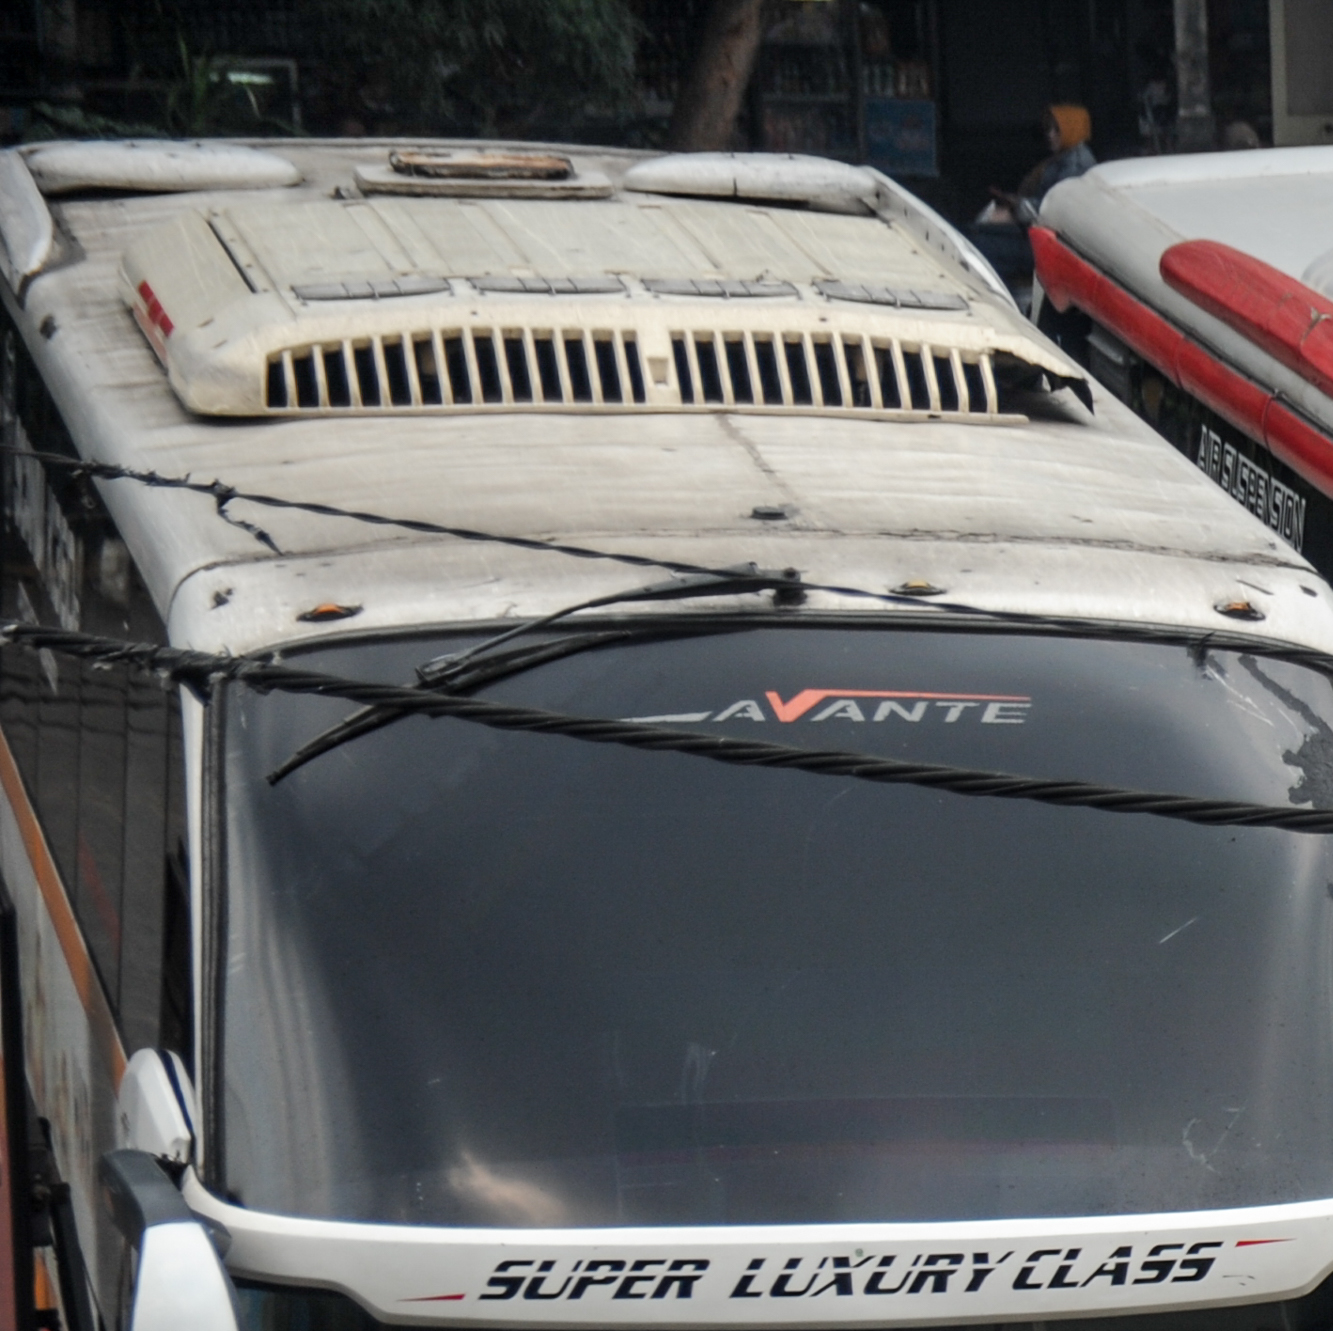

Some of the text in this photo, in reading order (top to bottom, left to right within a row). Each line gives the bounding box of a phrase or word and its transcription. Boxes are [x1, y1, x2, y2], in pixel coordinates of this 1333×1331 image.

[711, 689, 1032, 723] AVANTE
[477, 1241, 1224, 1301] SUPER LUXURY CLASS
